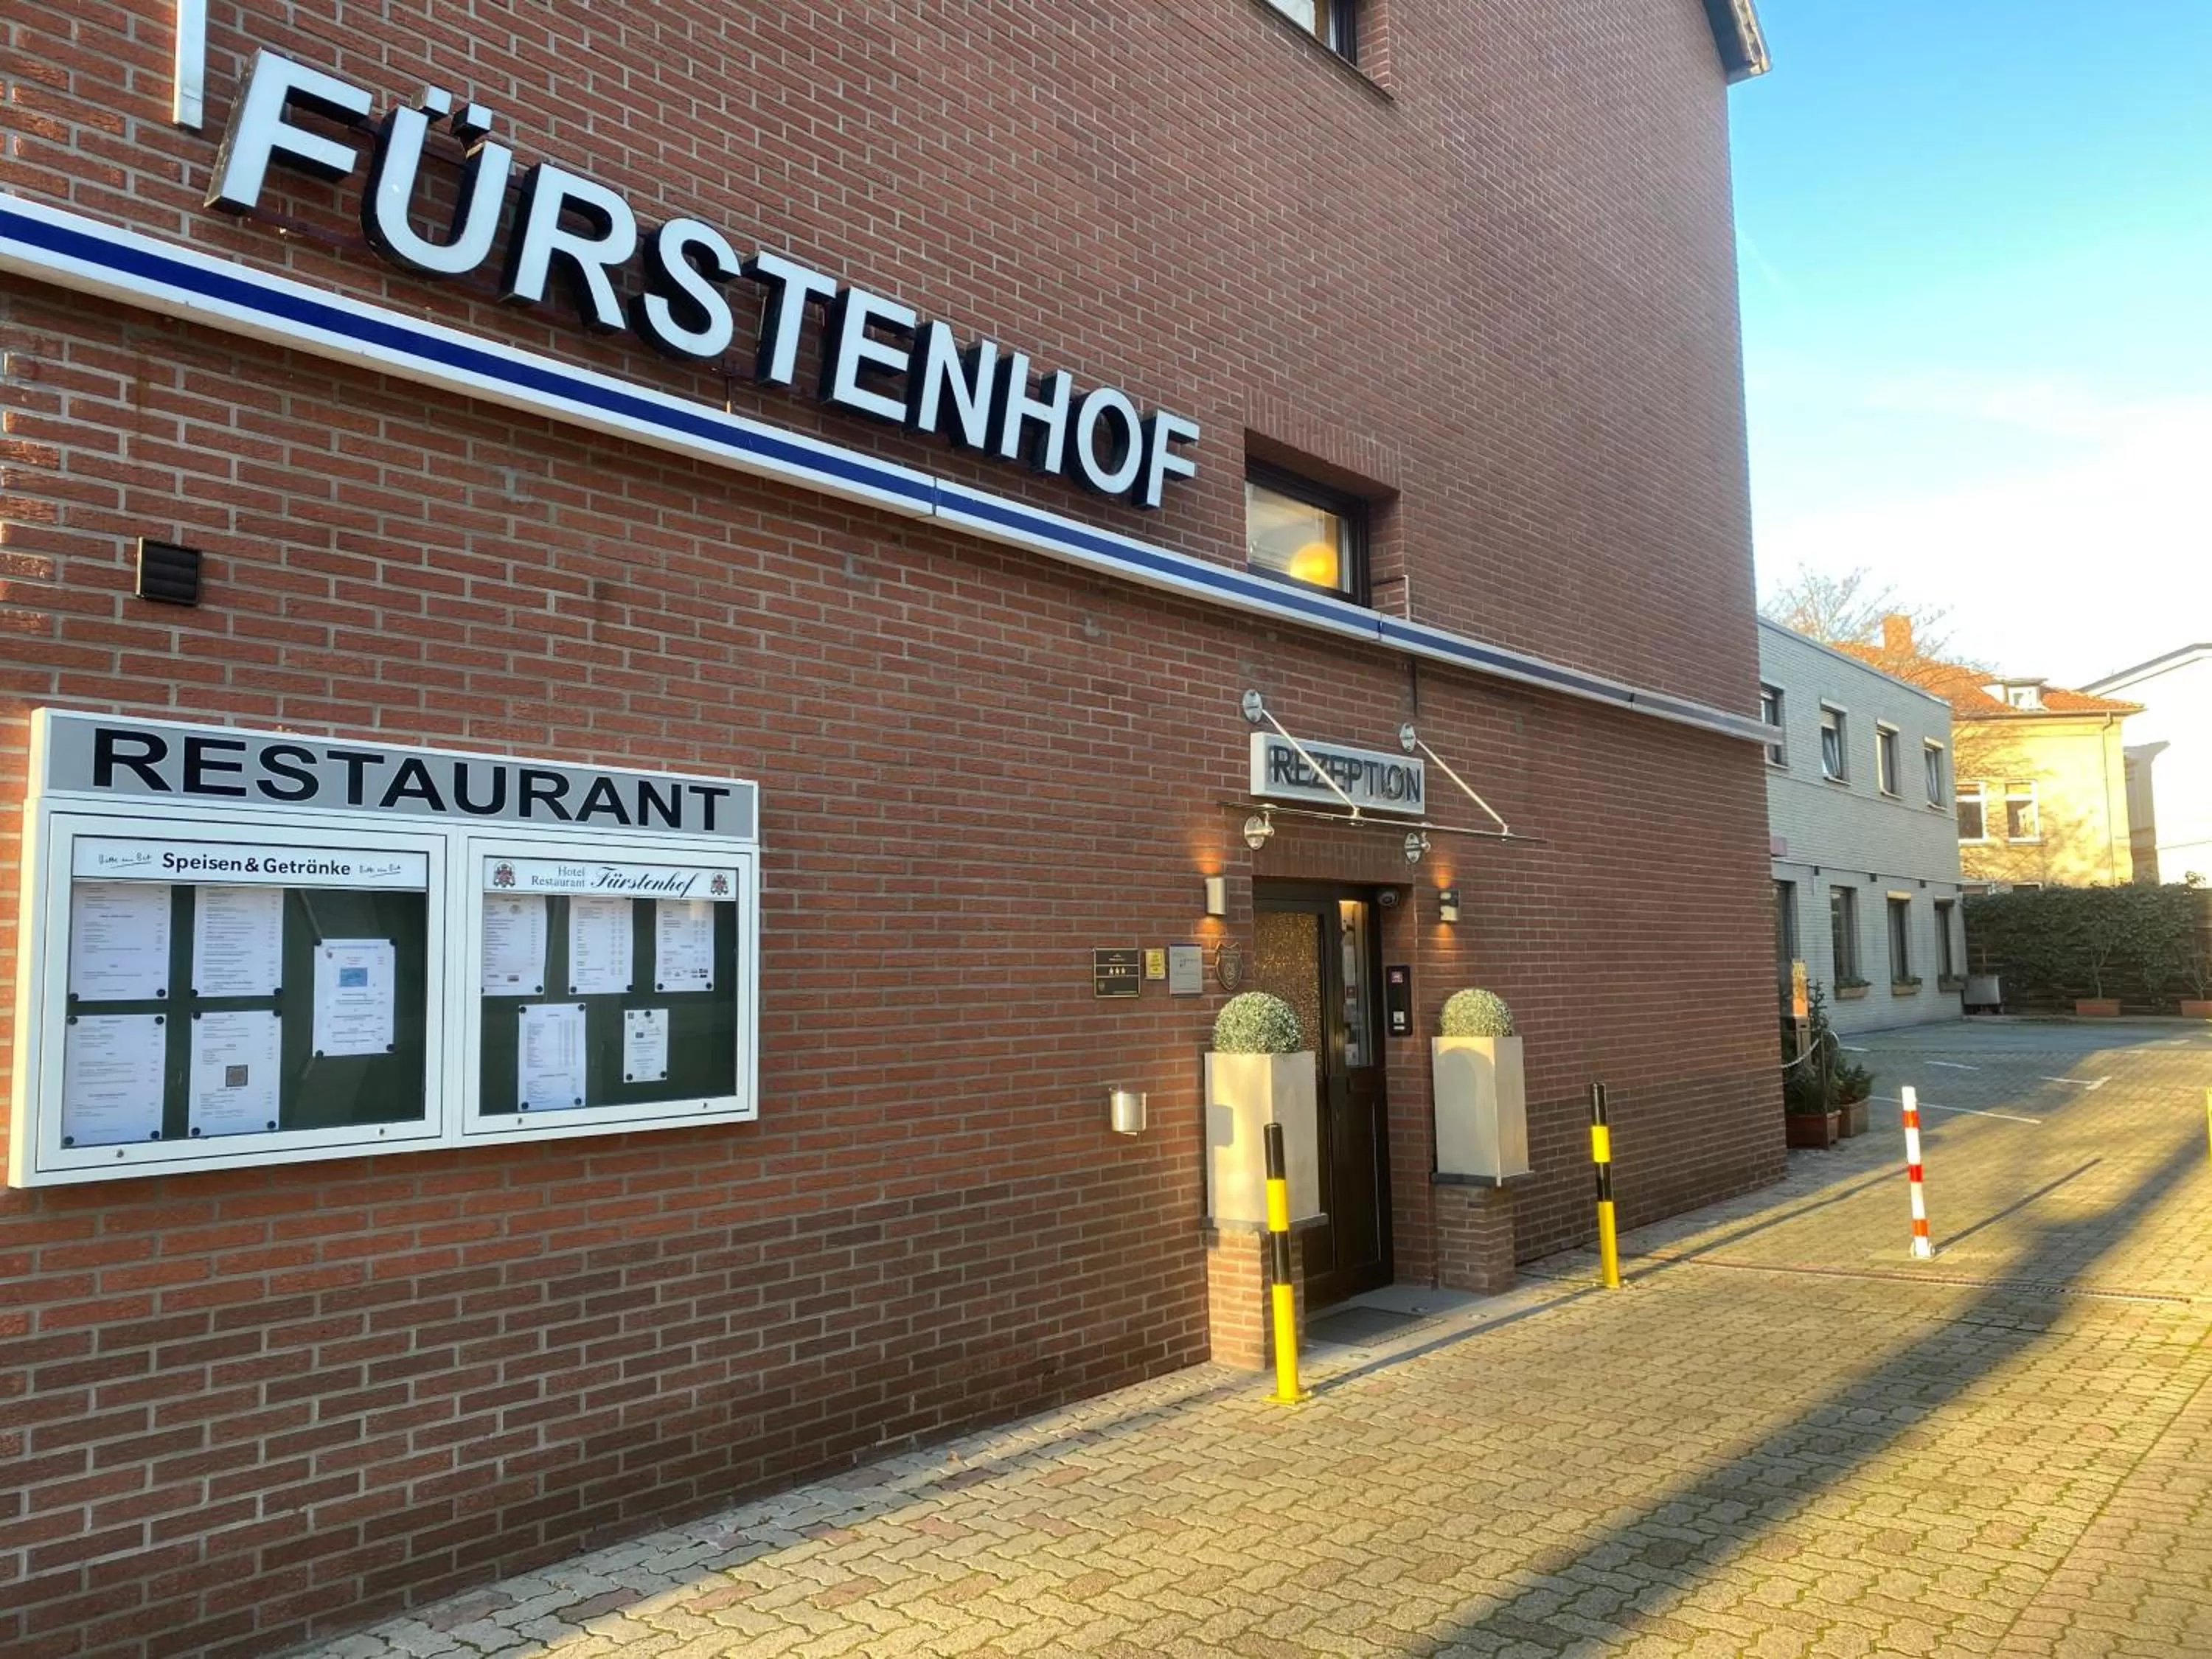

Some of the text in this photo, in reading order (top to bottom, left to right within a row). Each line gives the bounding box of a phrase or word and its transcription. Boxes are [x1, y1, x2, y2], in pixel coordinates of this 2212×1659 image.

[206, 46, 1201, 509] FÜRSTENHOF
[93, 728, 730, 831] RESTAURANT
[1271, 745, 1421, 803] REZEPTION
[162, 852, 242, 873] Speisen
[262, 858, 351, 875] Getränke
[558, 866, 585, 877] Hotel
[531, 876, 585, 889] Restaurant
[591, 866, 700, 897] Fürstenhof
